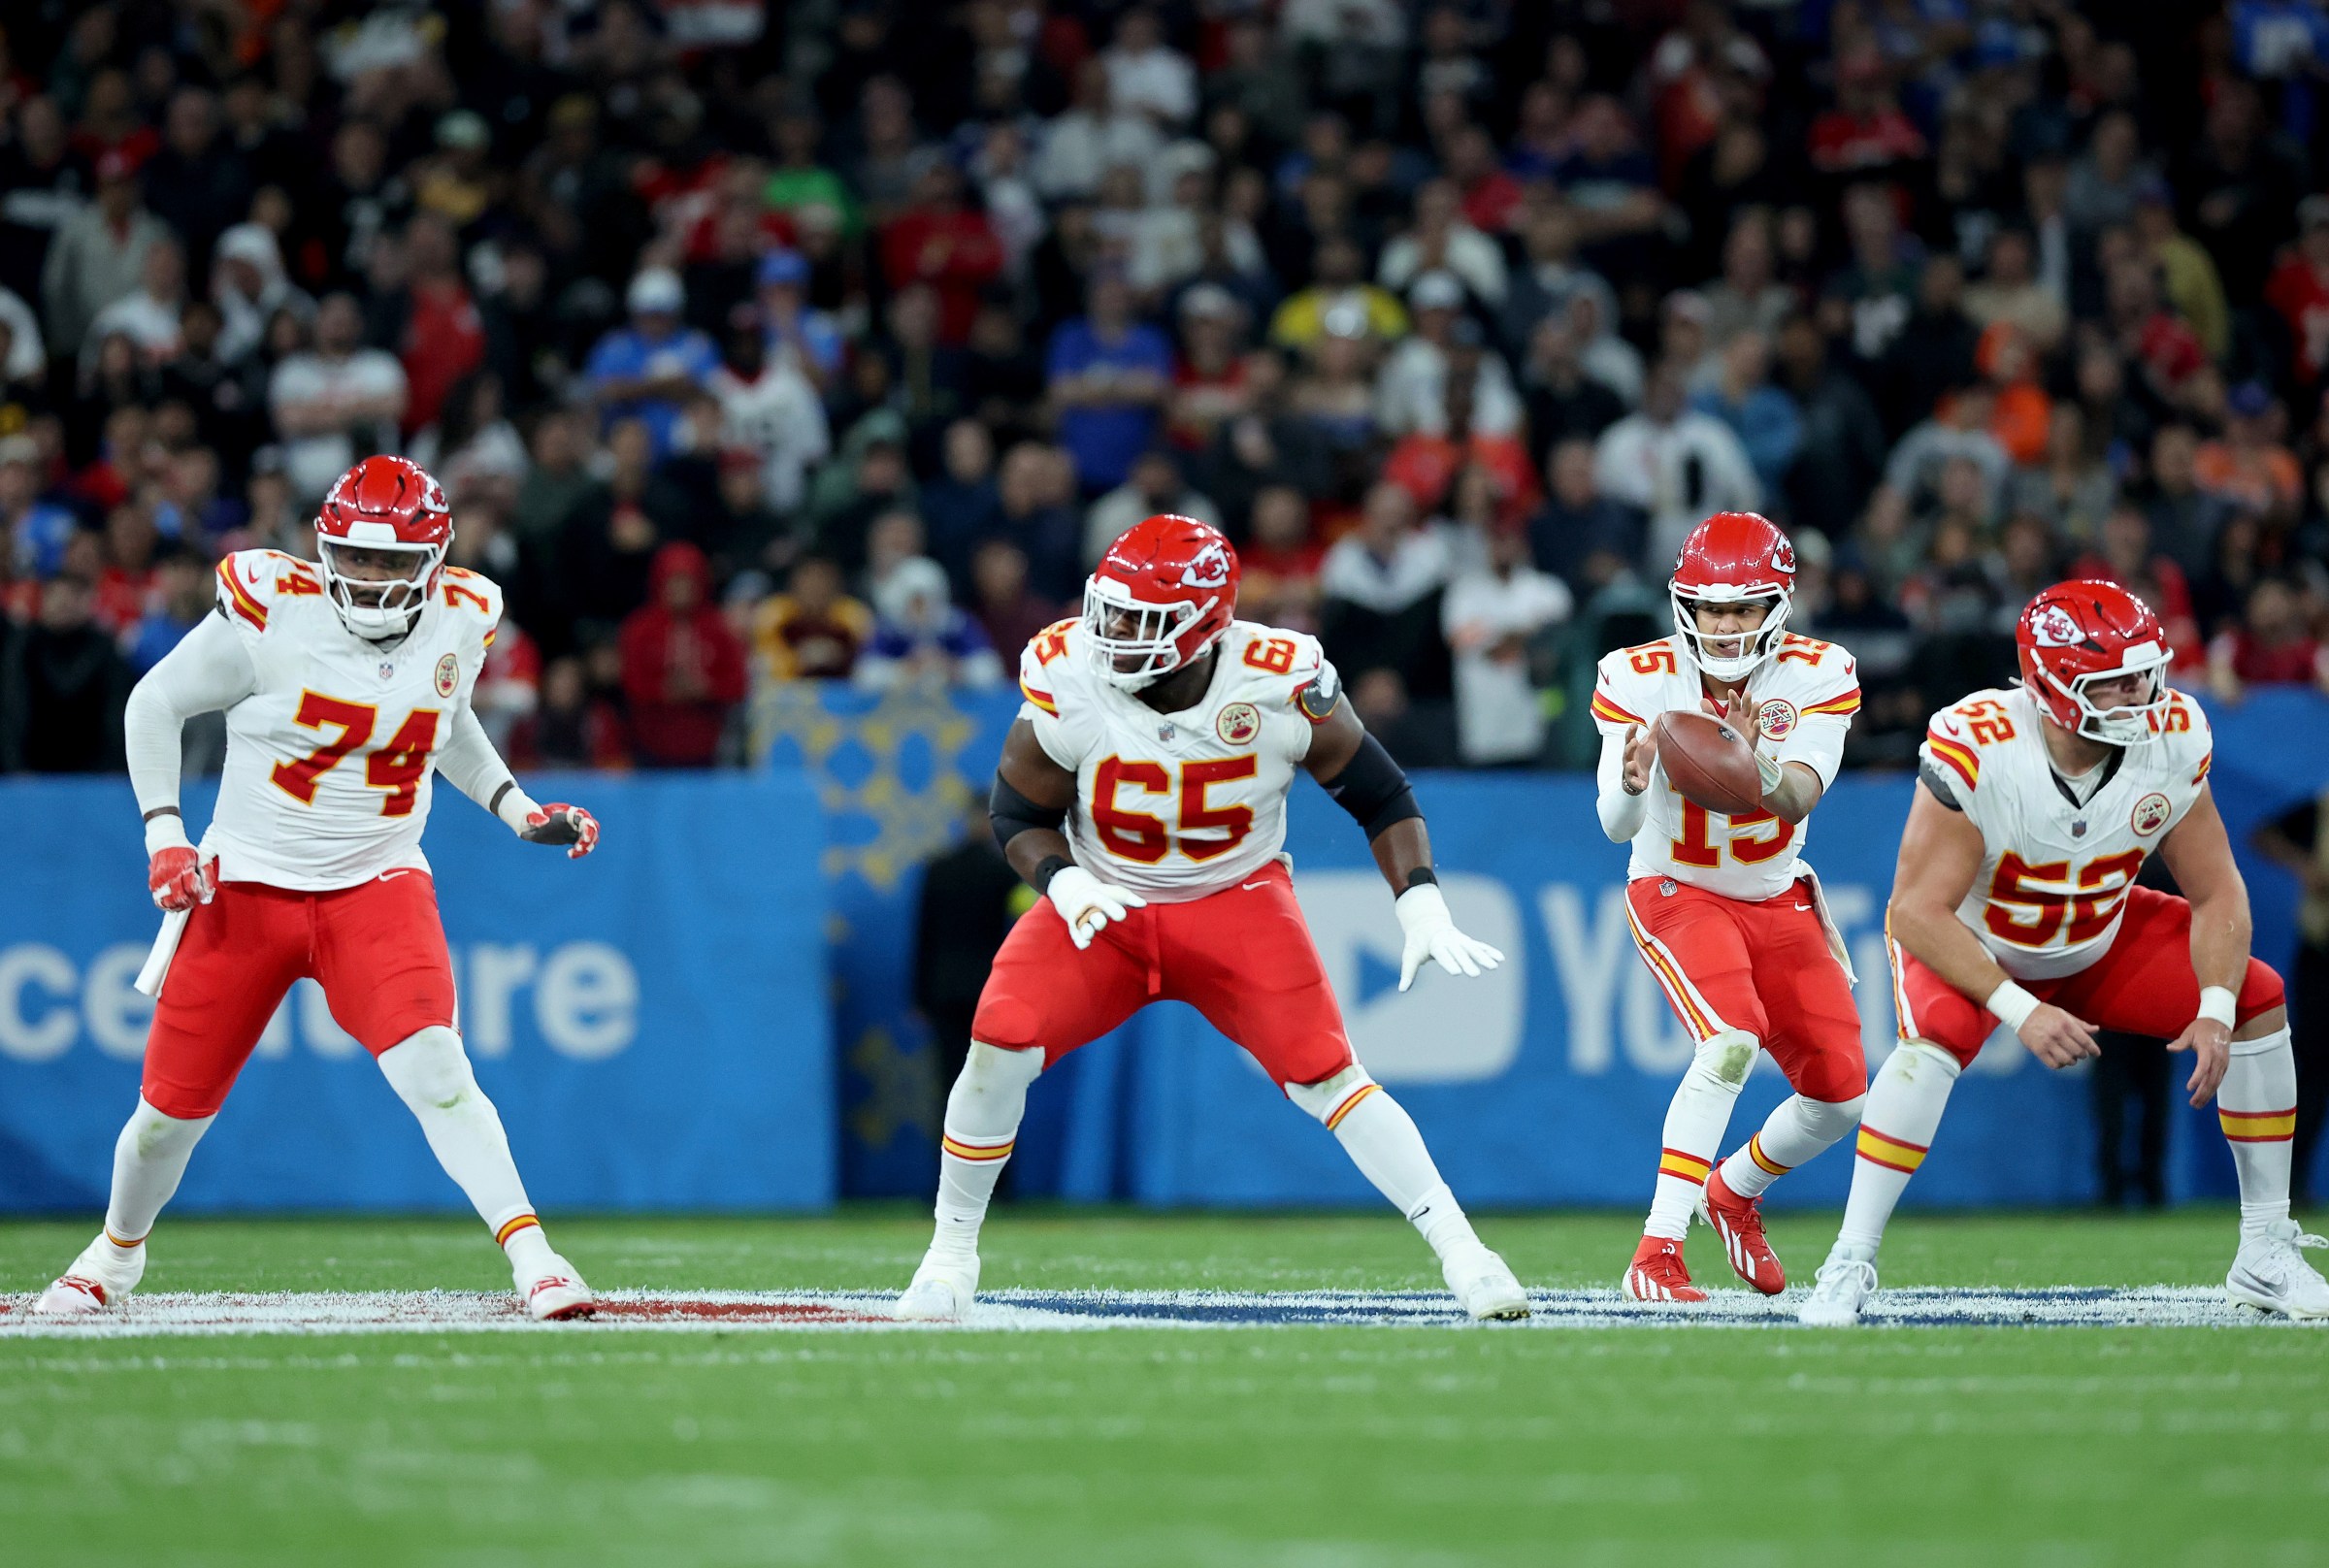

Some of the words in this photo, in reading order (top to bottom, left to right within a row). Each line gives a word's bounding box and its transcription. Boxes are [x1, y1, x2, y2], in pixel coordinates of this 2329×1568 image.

[443, 566, 489, 615] 7
[1243, 632, 1296, 674] 6
[1623, 639, 1677, 675] 15
[270, 687, 441, 818] 74
[1953, 699, 2016, 747] 52
[1091, 753, 1258, 866] 65
[1668, 773, 1796, 868] 15
[1984, 848, 2147, 948] 52
